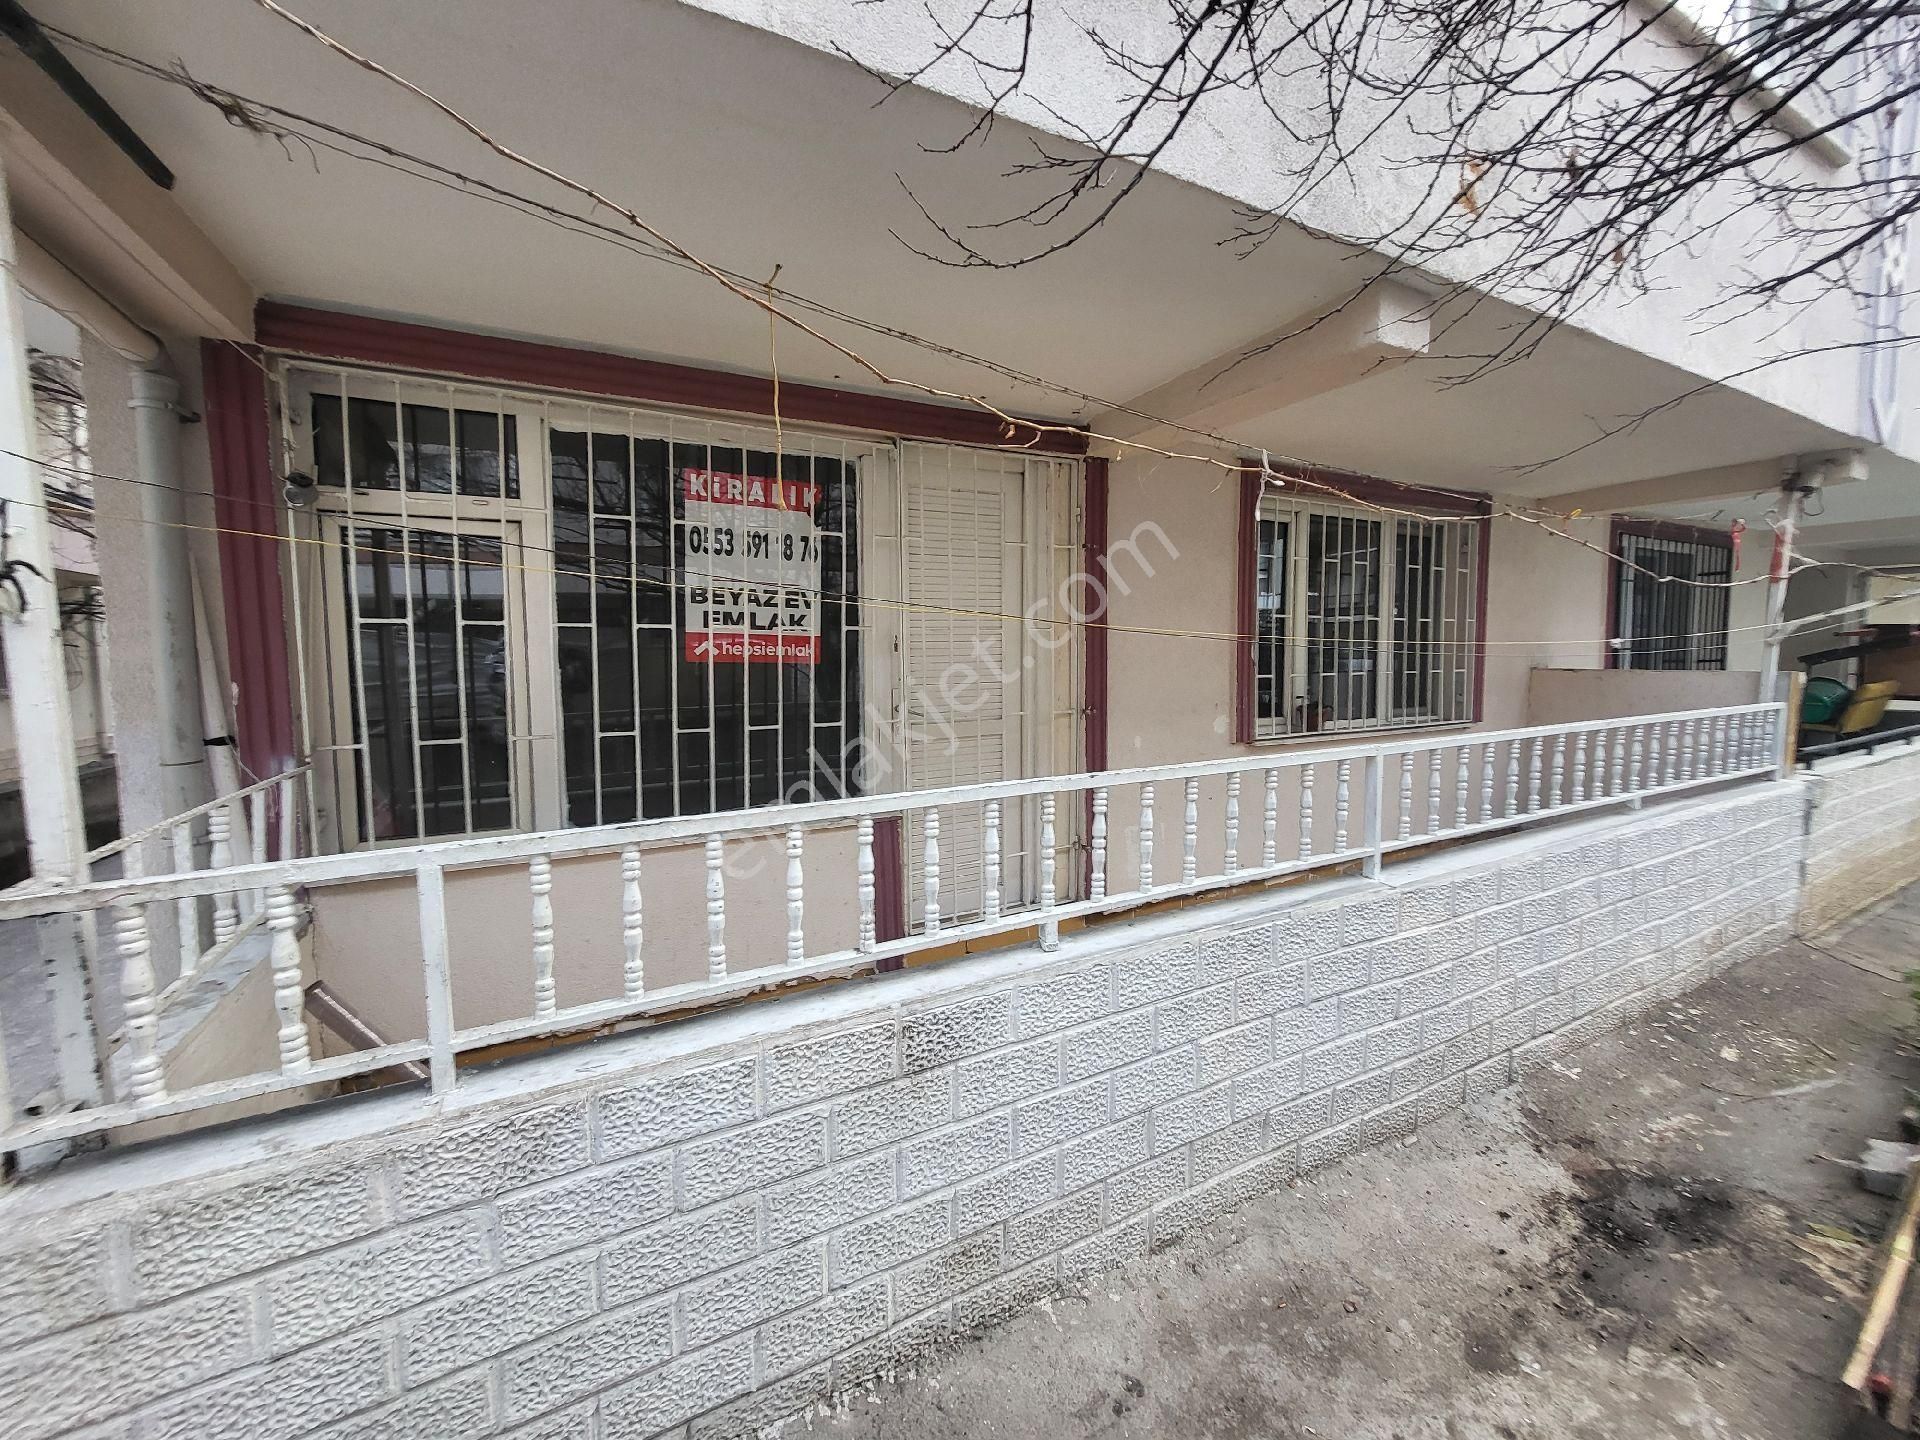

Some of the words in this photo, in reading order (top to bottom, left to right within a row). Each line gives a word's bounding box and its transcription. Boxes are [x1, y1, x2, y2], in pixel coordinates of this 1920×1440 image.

[690, 585, 779, 608] BEYAZ
[785, 590, 819, 610] EV
[703, 610, 808, 632] EMLAK
[721, 640, 814, 658] hepsiemlak
